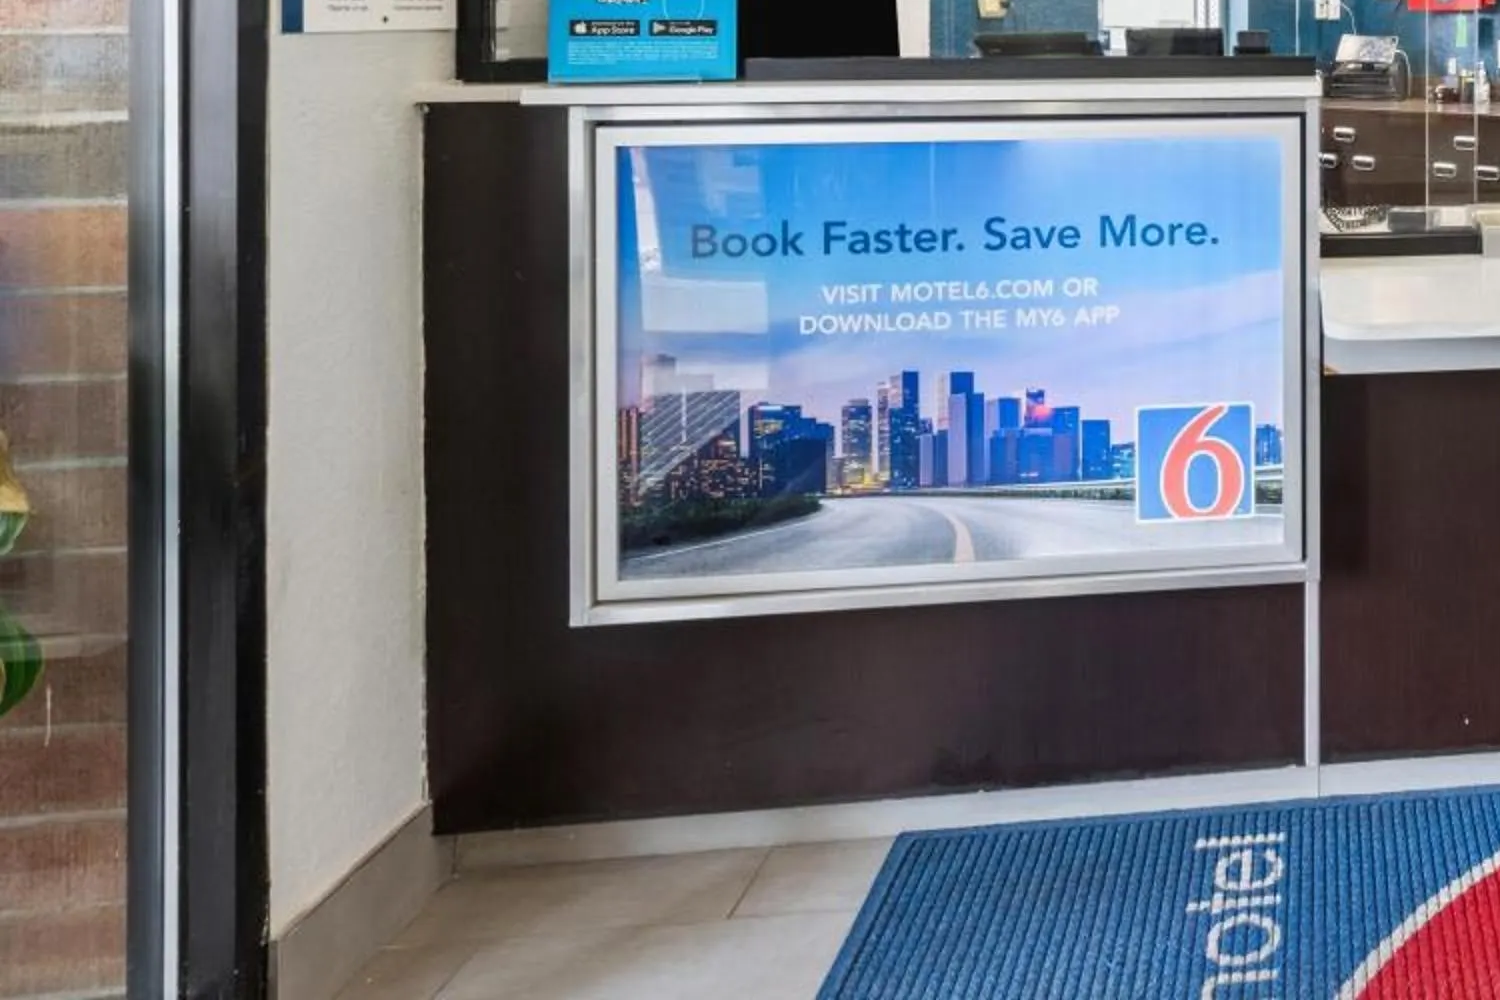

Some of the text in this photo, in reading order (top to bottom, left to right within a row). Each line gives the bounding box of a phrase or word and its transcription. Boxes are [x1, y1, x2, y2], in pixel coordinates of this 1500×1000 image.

[690, 213, 1219, 259] Book Faster. Save More.
[821, 277, 1100, 305] VISIT MOTEL6.COM OR
[800, 305, 1121, 335] DOWNLOAD THE MY6 APP
[1160, 403, 1246, 521] 6
